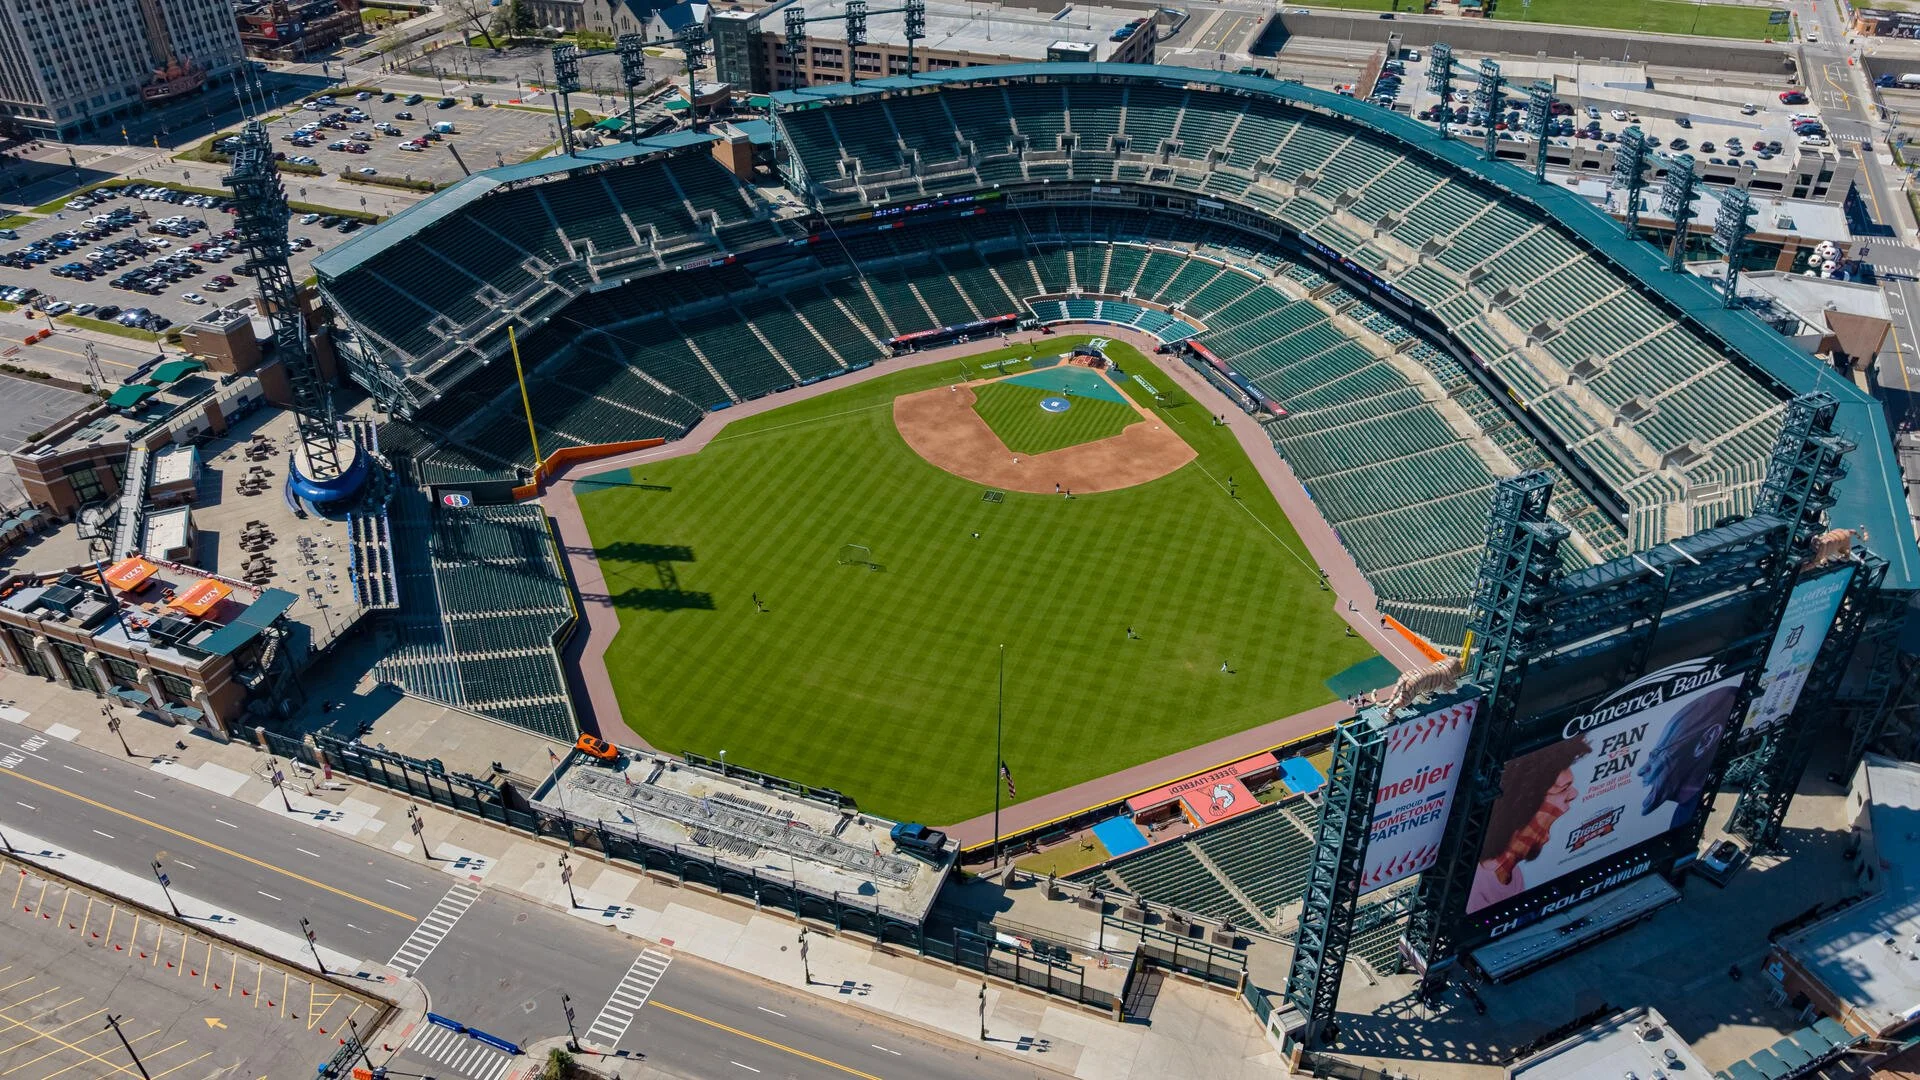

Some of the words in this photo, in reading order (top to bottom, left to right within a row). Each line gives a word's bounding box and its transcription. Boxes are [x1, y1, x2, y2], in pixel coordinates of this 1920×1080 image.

[119, 564, 145, 582] VIZZY
[194, 587, 220, 606] VIZZY
[1670, 663, 1727, 698] Bank
[20, 734, 49, 752] ONLY
[1598, 722, 1649, 757] FAN
[0, 751, 26, 769] ONLY
[1590, 749, 1640, 784] FAN
[1375, 761, 1454, 804] meijer
[1371, 799, 1444, 832] HOMETOWN
[1395, 799, 1423, 814] PROUD
[1369, 808, 1442, 842] PARTNER
[1603, 860, 1651, 889] PAVILION
